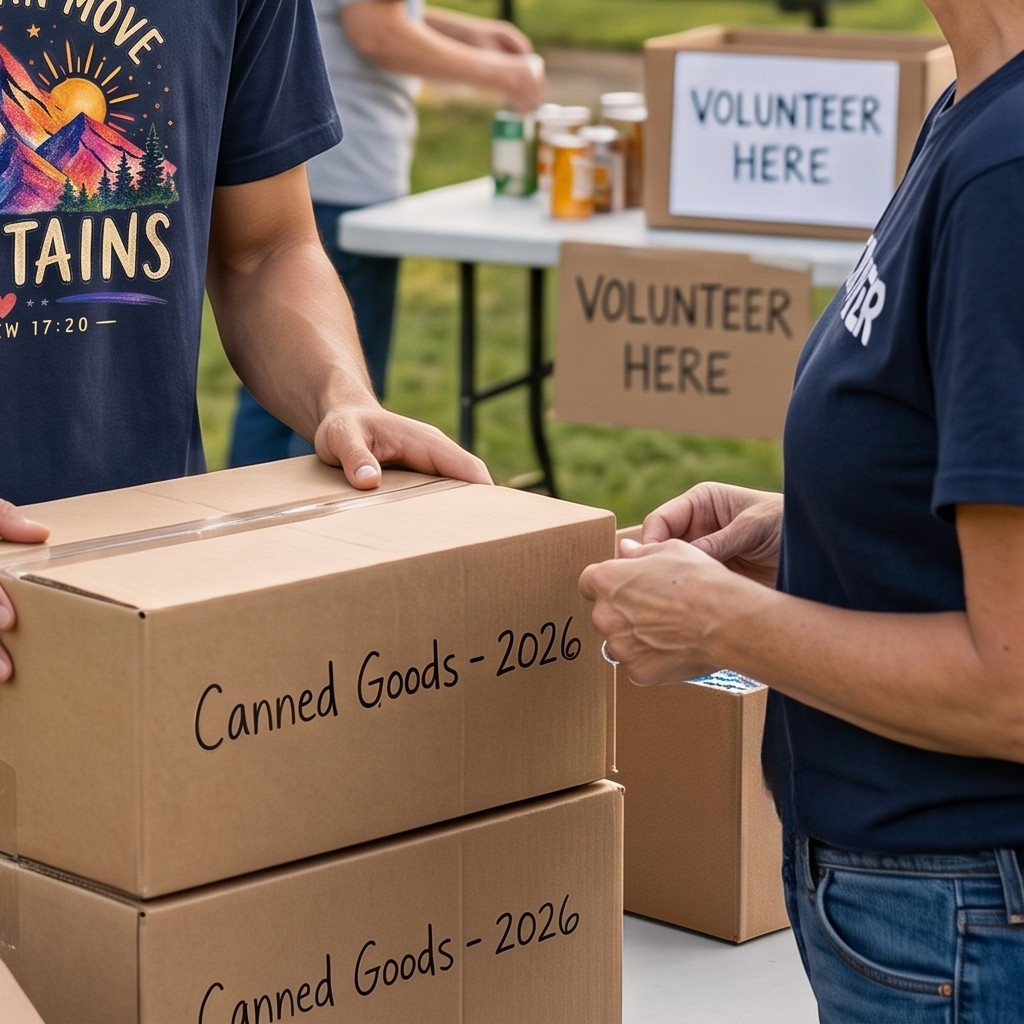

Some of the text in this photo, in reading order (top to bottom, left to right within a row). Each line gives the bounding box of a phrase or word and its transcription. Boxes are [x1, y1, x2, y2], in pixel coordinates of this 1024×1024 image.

[690, 88, 882, 135] VOLUNTEER
[733, 142, 831, 185] HERE
[32, 316, 89, 337] 17:20
[576, 275, 794, 339] VOLUNTEER
[623, 342, 731, 395] HERE
[194, 660, 339, 751] Canned
[357, 638, 459, 708] Goods
[495, 616, 582, 677] 2026
[198, 953, 335, 1024] Canned
[354, 923, 455, 997] Goods
[494, 893, 581, 956] 2026
